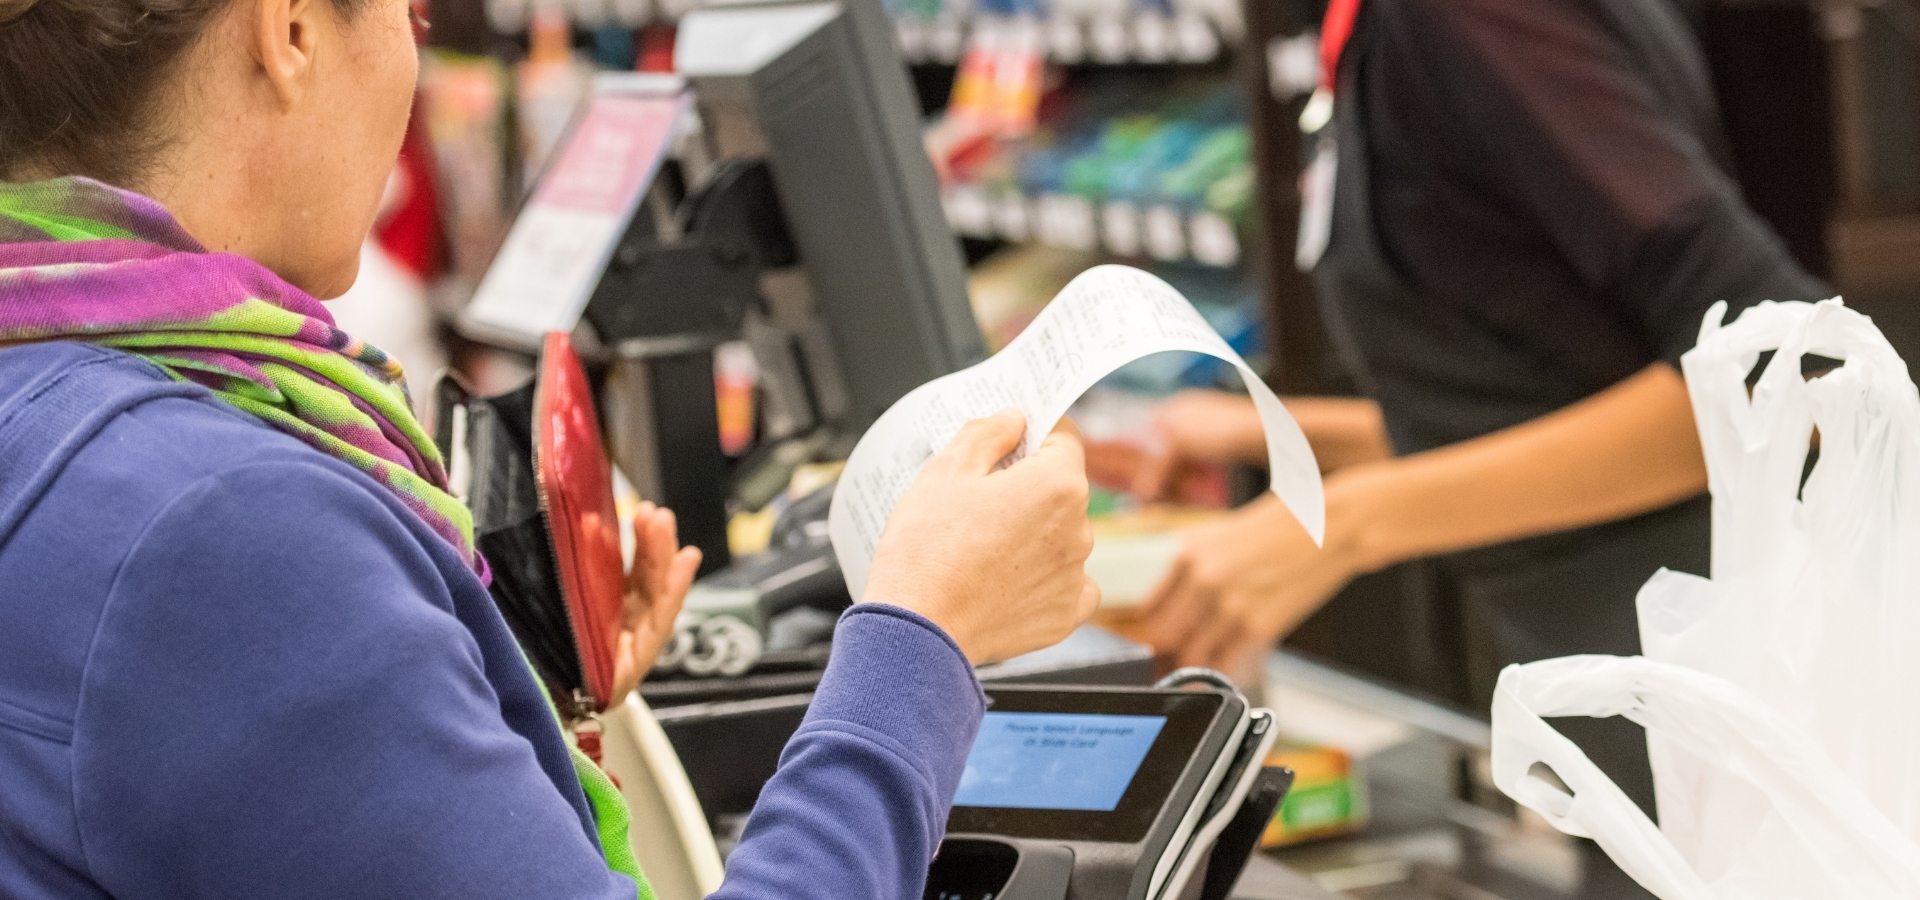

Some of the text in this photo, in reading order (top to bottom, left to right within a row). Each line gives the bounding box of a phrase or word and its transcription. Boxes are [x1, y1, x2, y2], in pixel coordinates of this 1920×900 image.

[1004, 722, 1135, 737] Please Select Language
[1040, 737, 1067, 748] Slide
[1069, 737, 1099, 748] Card
